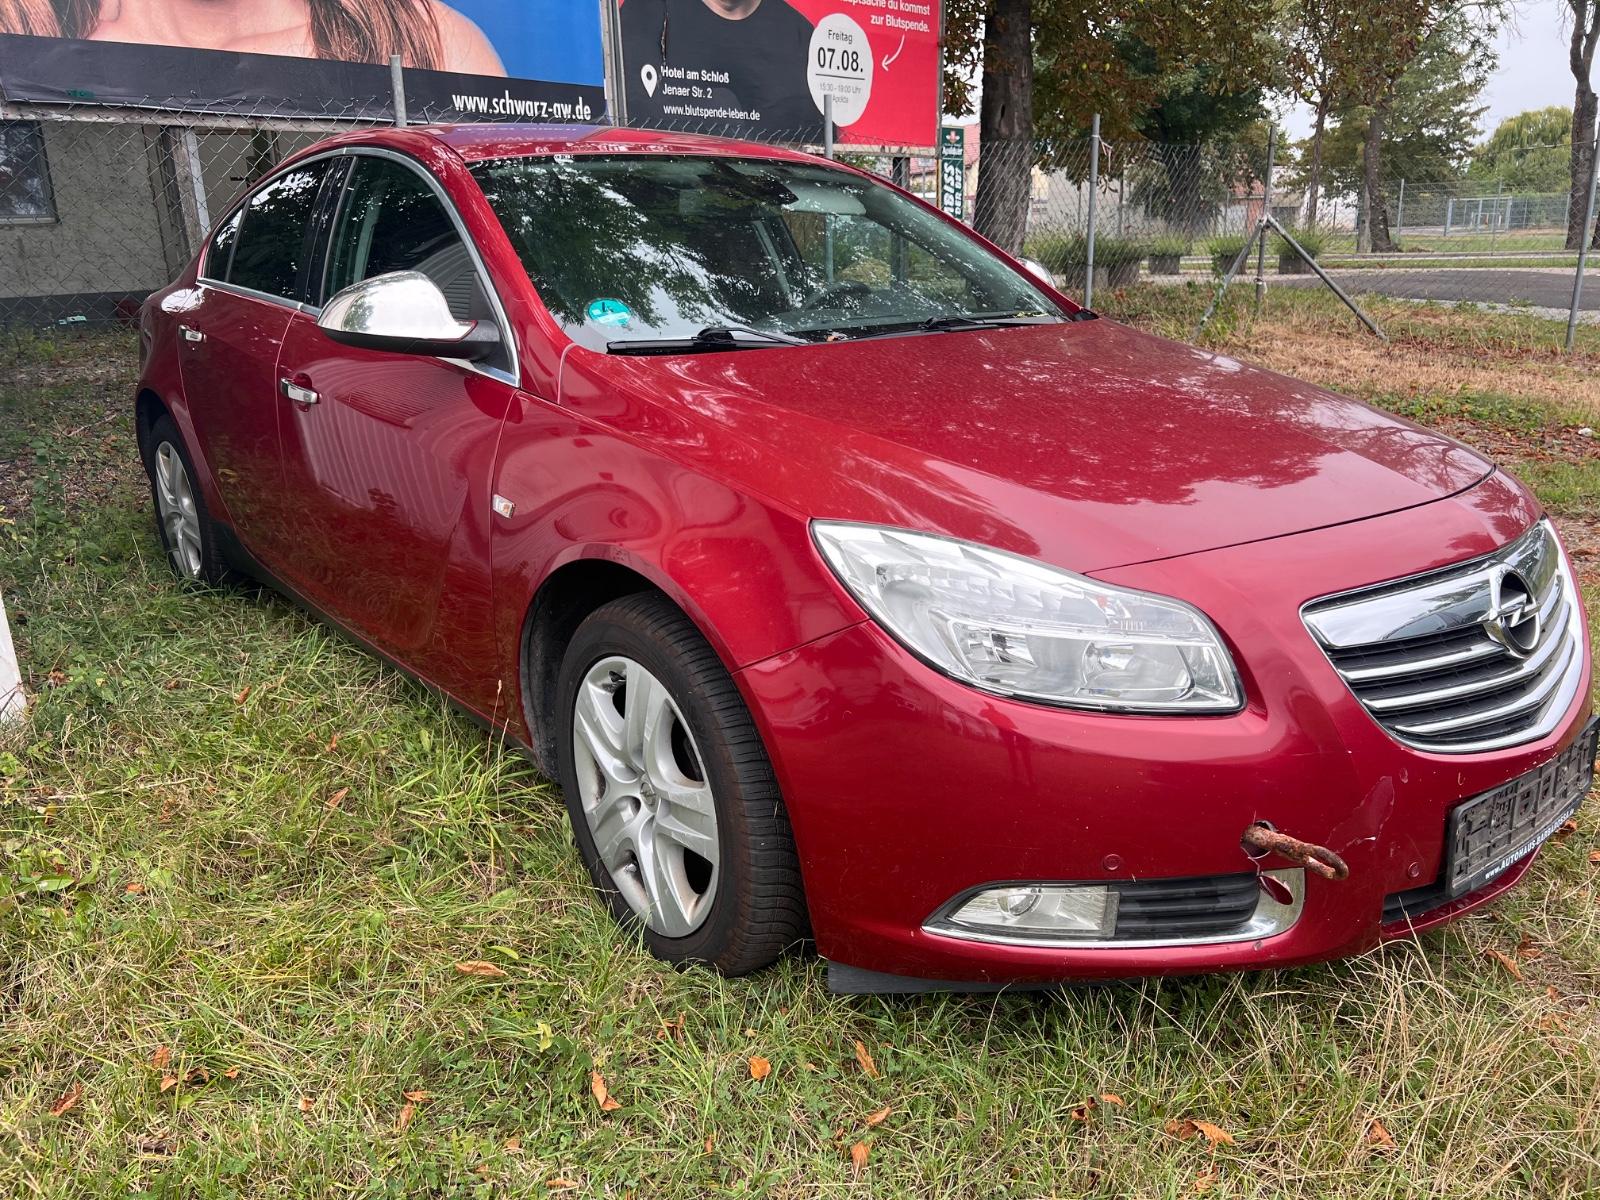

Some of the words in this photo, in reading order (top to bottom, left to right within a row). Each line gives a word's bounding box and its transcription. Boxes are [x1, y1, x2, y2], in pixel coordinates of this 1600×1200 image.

[887, 0, 898, 10] du
[899, 2, 930, 16] kommst
[870, 14, 884, 25] zur
[885, 14, 930, 32] Blutspende.
[828, 29, 853, 45] Freitag
[817, 46, 864, 73] 07.08.
[662, 66, 684, 79] Hotel
[686, 70, 699, 80] am
[701, 69, 730, 84] Schloß
[662, 83, 690, 97] Jenaer
[691, 86, 706, 98] Str.
[706, 87, 713, 99] 2
[452, 90, 592, 121] www.schwarz-aw.de
[663, 104, 761, 121] www.blutspende-leben.de
[943, 162, 955, 214] BISS
